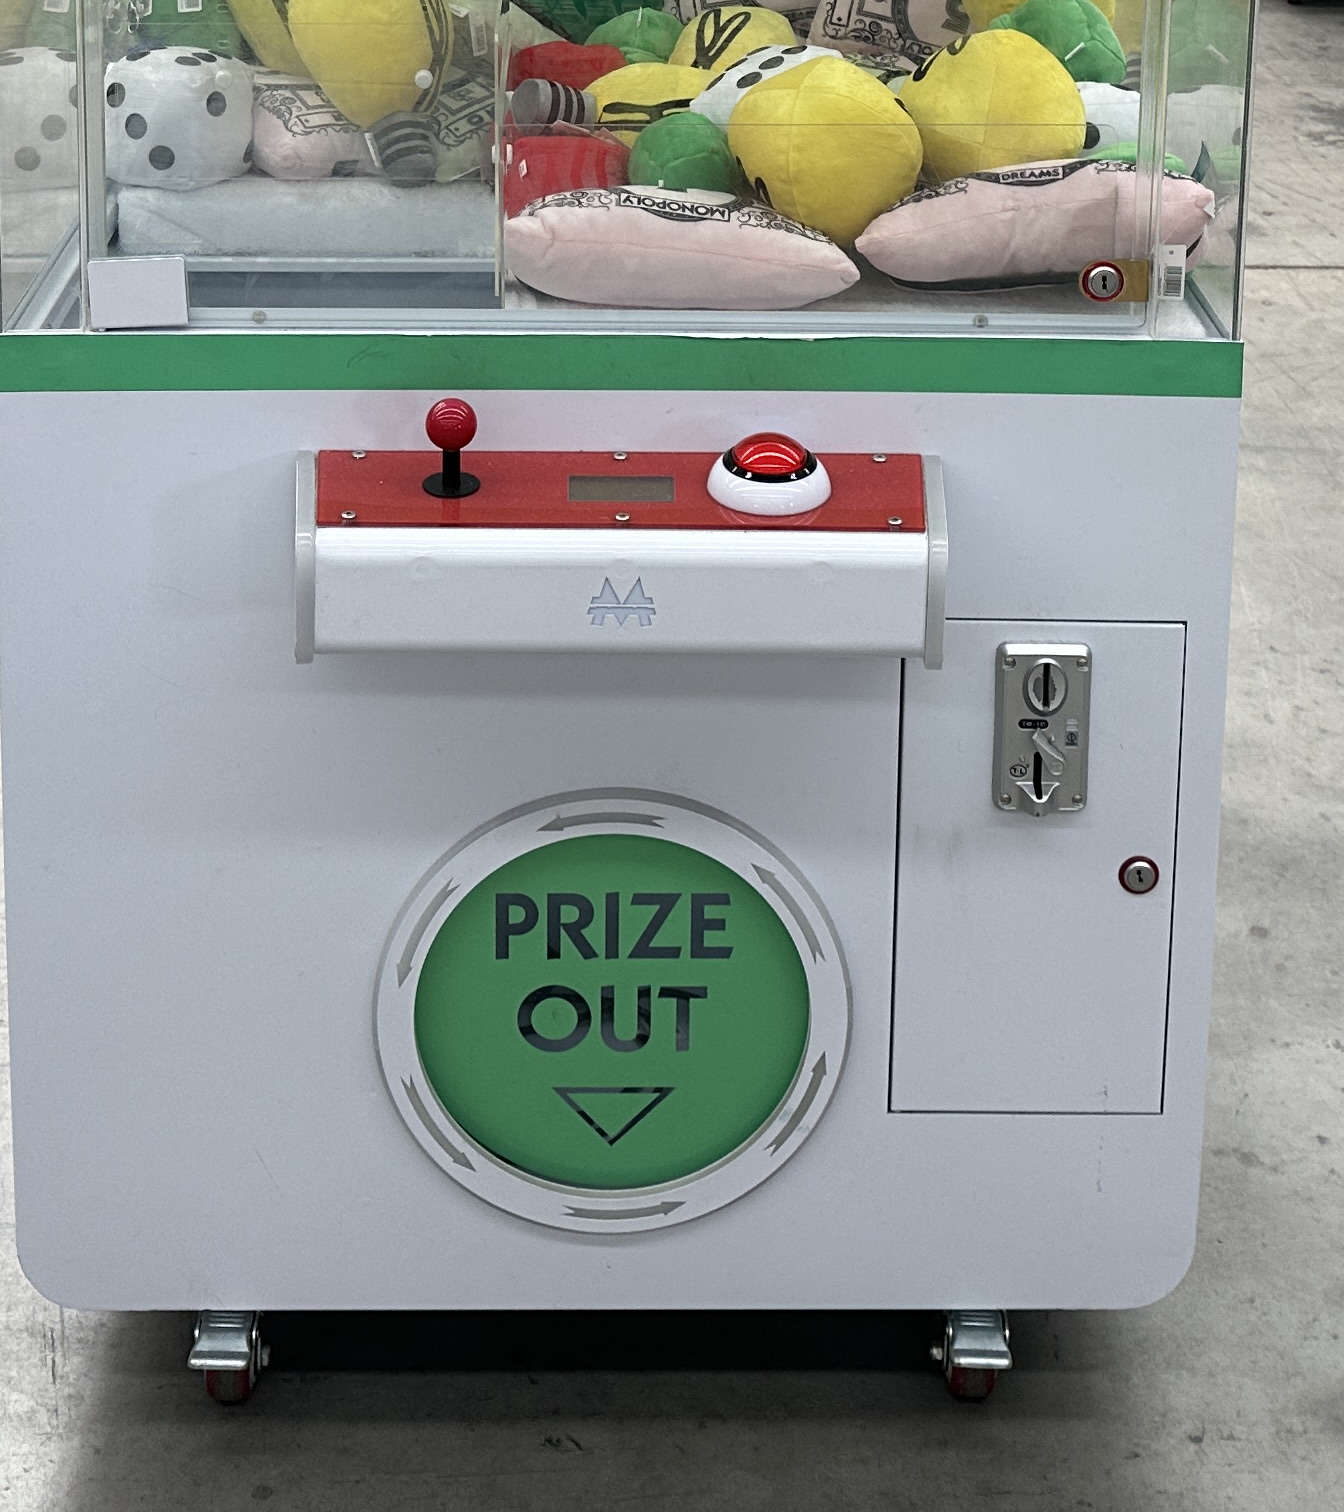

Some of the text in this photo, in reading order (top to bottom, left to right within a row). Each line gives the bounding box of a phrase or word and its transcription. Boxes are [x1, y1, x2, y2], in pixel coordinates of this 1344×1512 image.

[1000, 166, 1062, 183] DREAMS
[621, 194, 727, 219] MONOPOLY
[494, 891, 734, 961] PRIZE
[516, 984, 709, 1053] OUT
